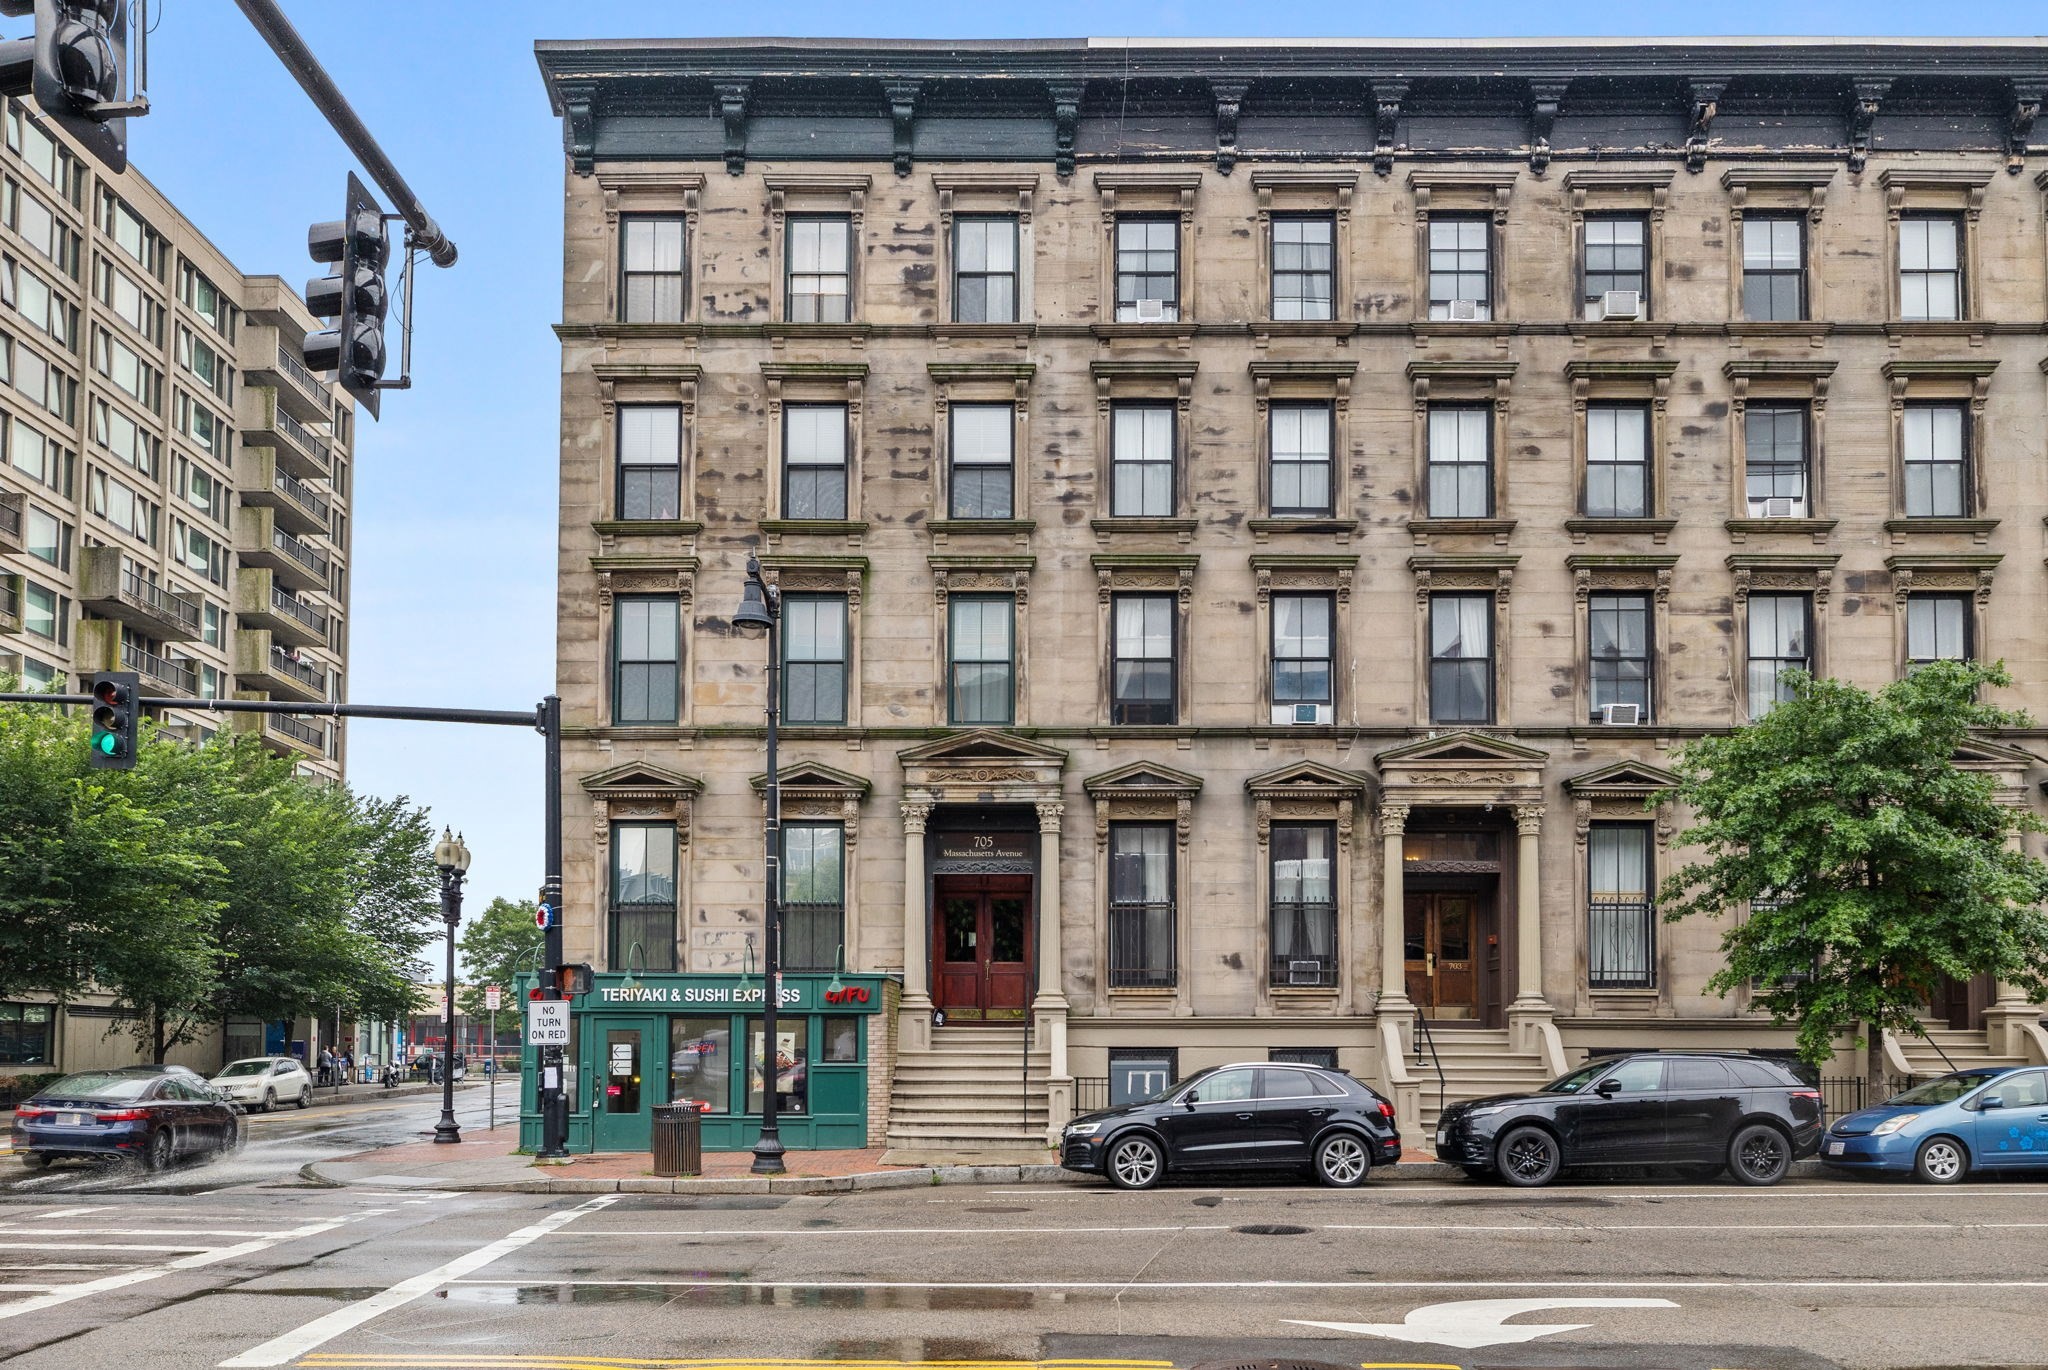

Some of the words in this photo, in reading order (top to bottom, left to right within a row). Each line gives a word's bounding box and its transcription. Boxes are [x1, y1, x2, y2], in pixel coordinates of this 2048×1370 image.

[974, 836, 993, 848] 705
[944, 849, 994, 857] Massachusetts
[996, 849, 1023, 857] Avenue
[601, 988, 666, 1002] TERIYAKI
[670, 989, 681, 1002] &
[685, 988, 729, 1002] SUSHI
[733, 988, 800, 1002] EXPSS
[542, 1006, 555, 1015] NO
[537, 1018, 561, 1027] TURN
[532, 1030, 545, 1039] ON
[548, 1030, 566, 1039] RED
[688, 1044, 716, 1054] OPEN
